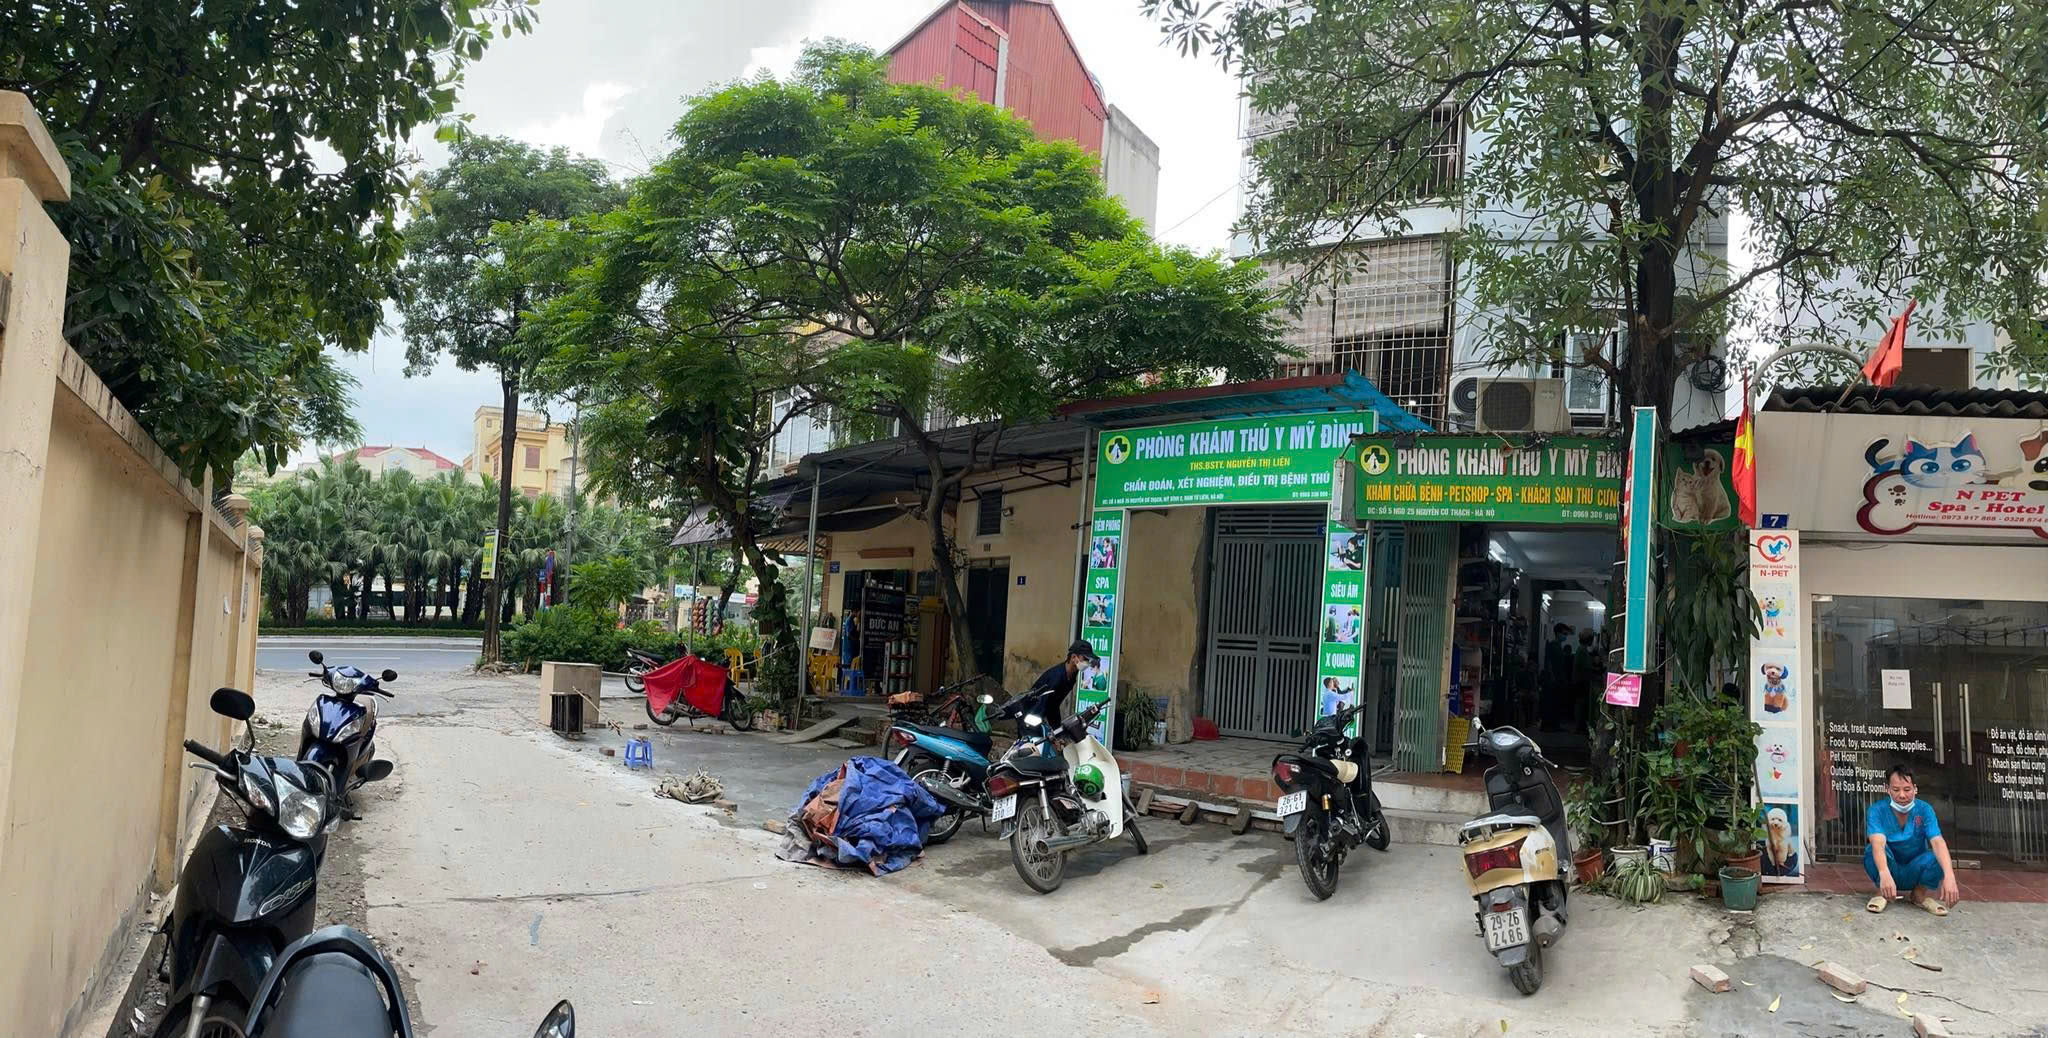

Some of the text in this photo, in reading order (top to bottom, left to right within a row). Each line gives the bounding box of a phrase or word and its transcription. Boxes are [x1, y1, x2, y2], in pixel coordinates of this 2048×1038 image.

[1136, 419, 1364, 460] PHÒNG KHÁM THÚ Y MỸ ĐÌNH
[1397, 444, 1450, 475] PHÒNG
[1456, 443, 1505, 476] KHÁM
[1549, 448, 1560, 475] Y
[1564, 444, 1589, 476] MỸ
[1595, 445, 1621, 479] ĐÌN
[1177, 476, 1194, 489] XÉT
[1262, 474, 1278, 487] TRỊ
[1281, 472, 1308, 487] BỆNH
[1311, 471, 1331, 484] THÚ
[1366, 482, 1391, 501] KHÁM
[1393, 482, 1416, 502] CHỮA
[1420, 482, 1443, 505] BỆNH
[1449, 485, 1490, 503] PETSHOP
[1496, 486, 1513, 503] SPA
[1521, 484, 1551, 504] KHÁCH
[1555, 487, 1573, 507] SẠN
[1577, 485, 1593, 504] THÚ
[1956, 490, 2026, 502] N PET
[1928, 501, 1966, 513] Spa
[1986, 503, 2046, 514] Hotel
[1770, 515, 1779, 527] 7
[1095, 576, 1110, 589] SPA
[1330, 581, 1358, 598] SIÊU ÂM
[887, 619, 900, 631] AN
[1325, 653, 1356, 668] X QUANG
[1829, 722, 1908, 737] Snack, treat, supplements
[1830, 736, 1847, 748] Food,
[1848, 738, 1860, 750] toy,
[1860, 738, 1899, 751] accessories,
[1830, 751, 1858, 762] Pet Hotel
[1830, 765, 1854, 777] Outside
[1831, 780, 1842, 791] Pet
[1843, 780, 1855, 793] Spa
[1856, 781, 1861, 792] &
[243, 838, 272, 849] HONDA
[1492, 927, 1523, 947] 2486
